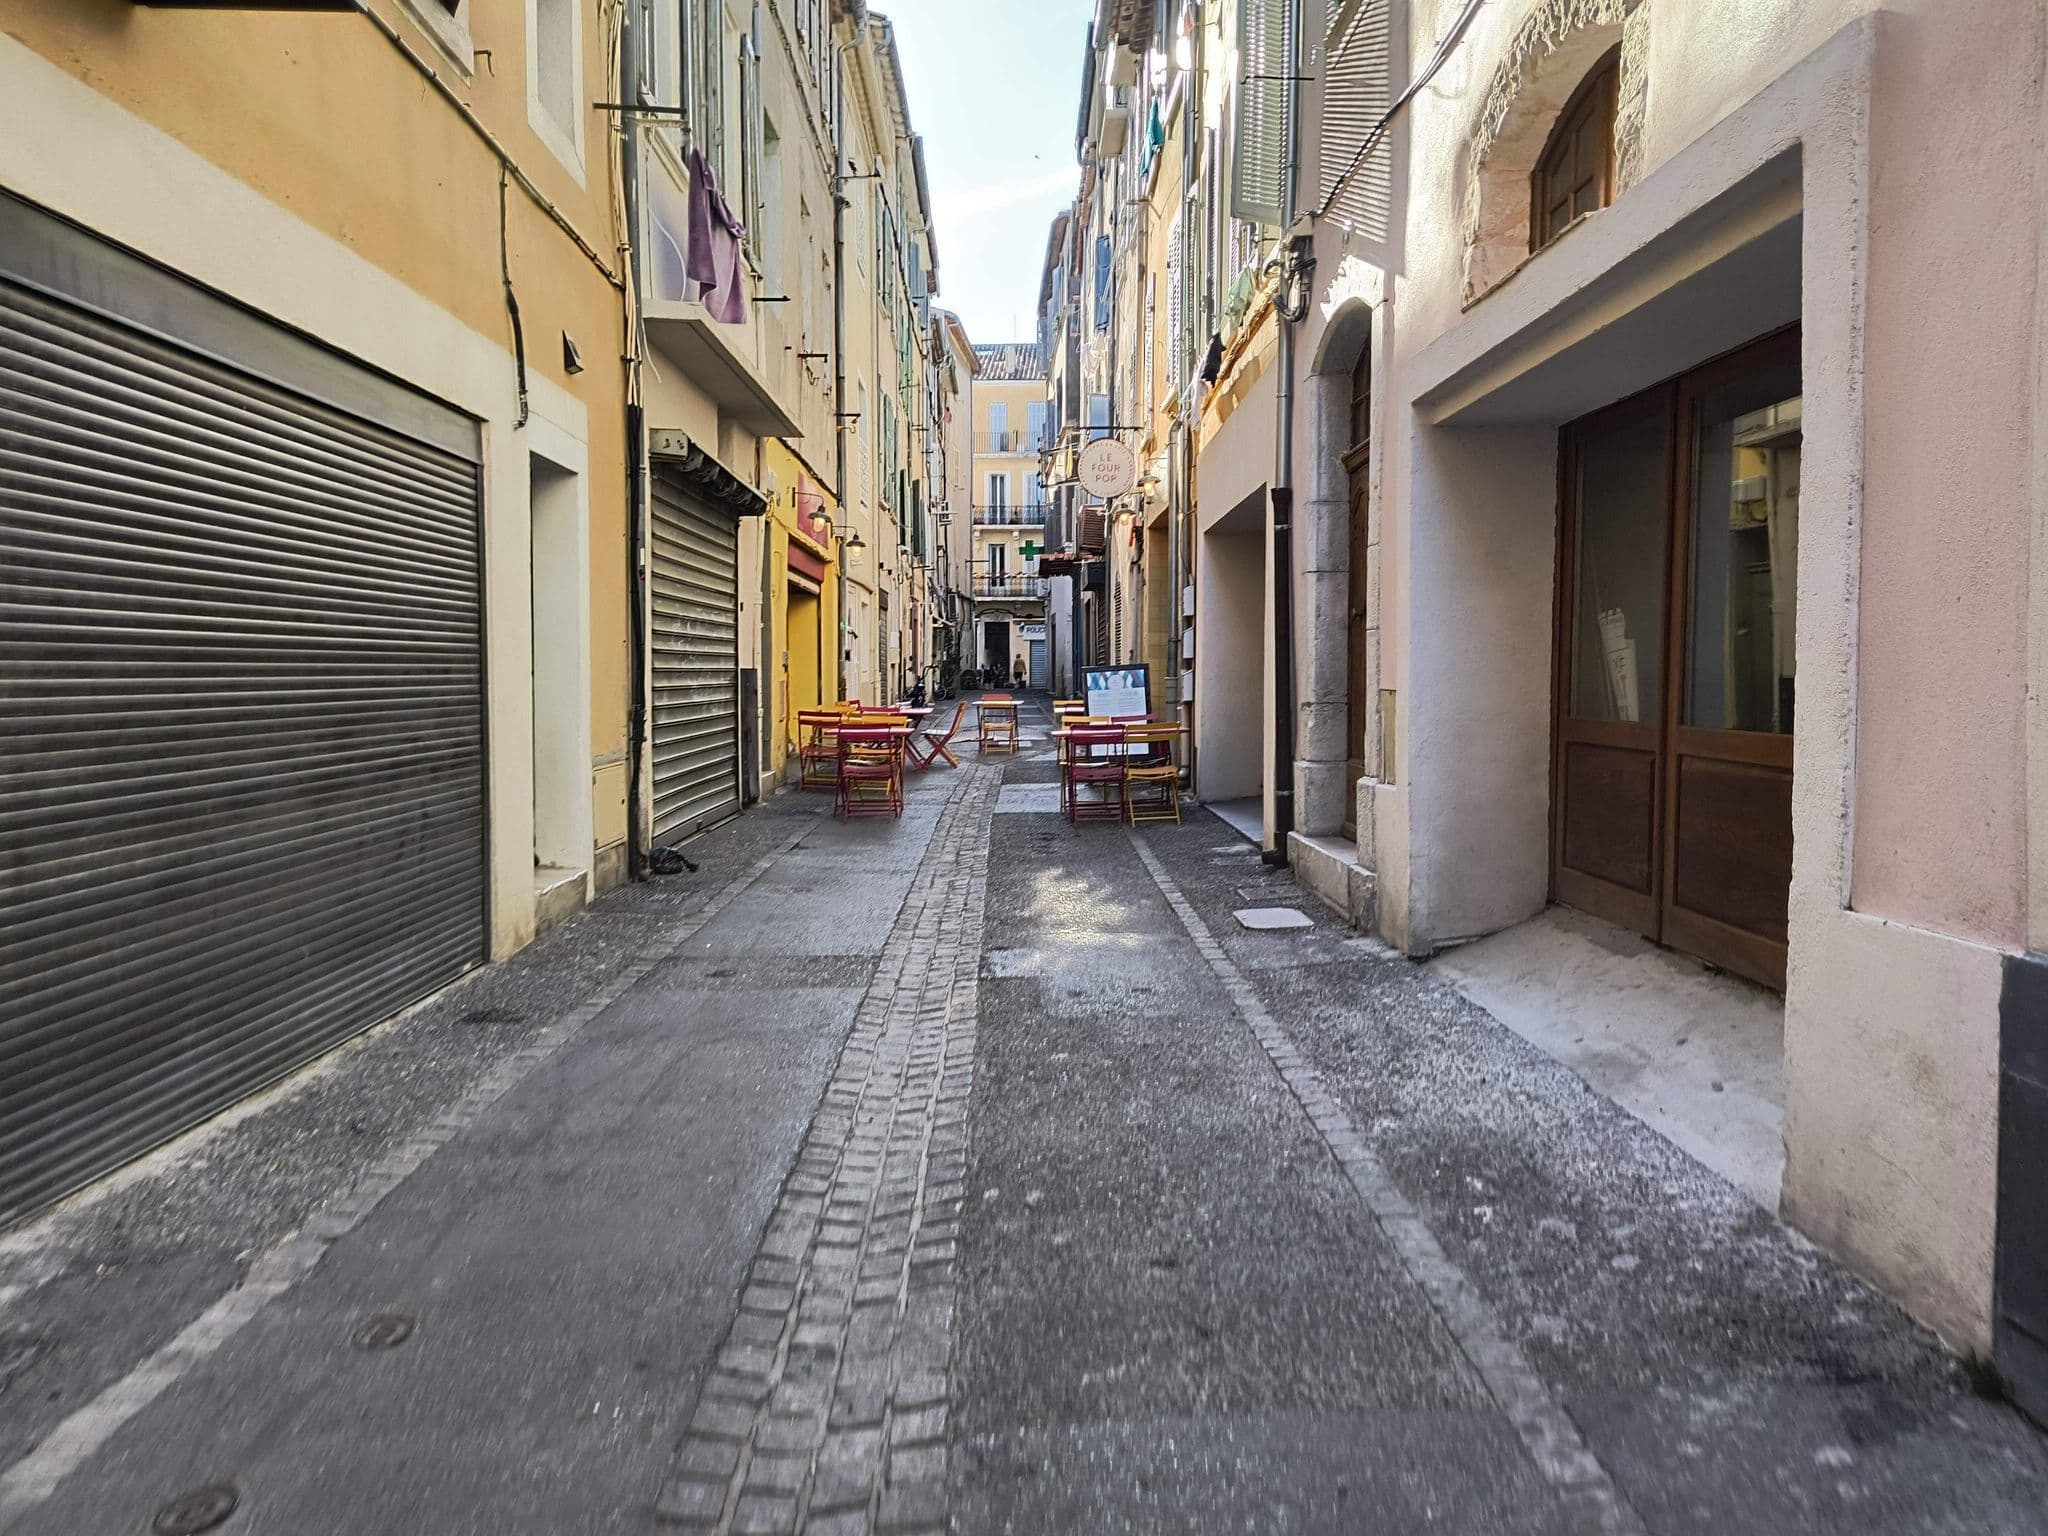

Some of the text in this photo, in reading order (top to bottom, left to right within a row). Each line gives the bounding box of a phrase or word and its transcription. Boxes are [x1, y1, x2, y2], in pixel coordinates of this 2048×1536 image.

[1100, 453, 1112, 462] LE
[1091, 464, 1121, 473] FOUR
[1095, 474, 1117, 483] POP
